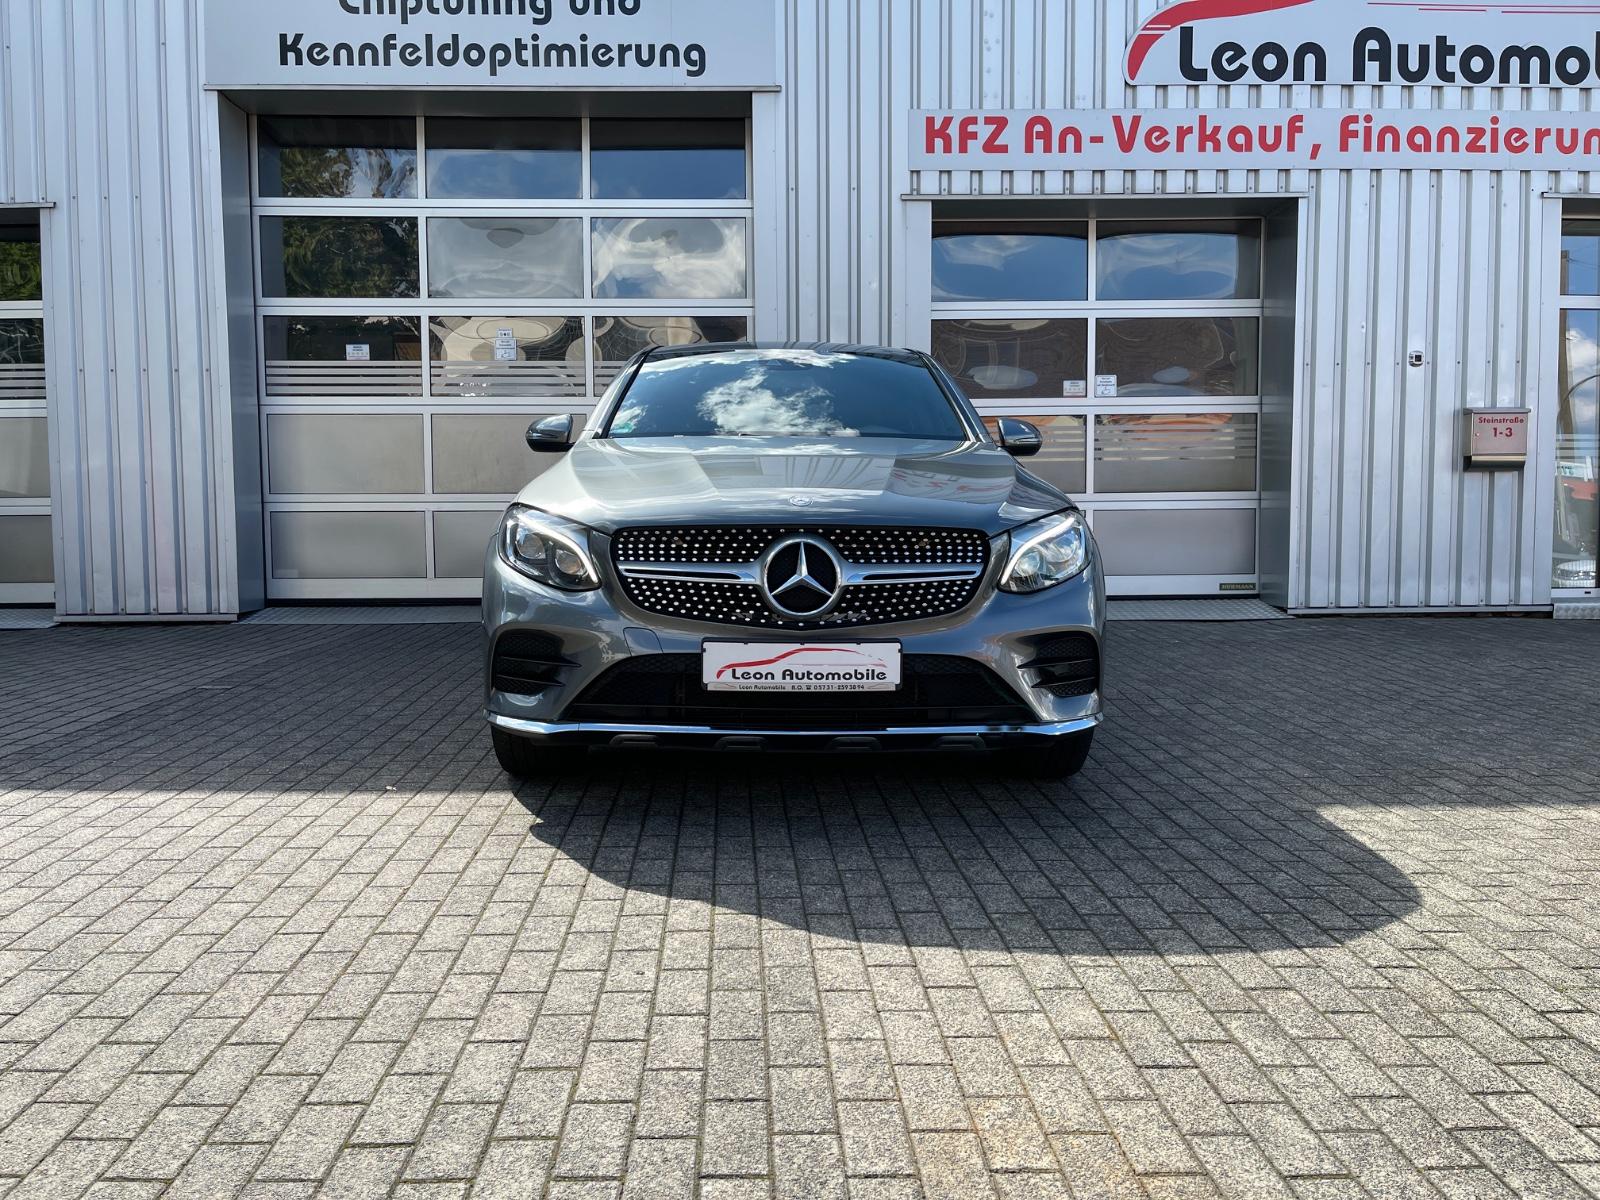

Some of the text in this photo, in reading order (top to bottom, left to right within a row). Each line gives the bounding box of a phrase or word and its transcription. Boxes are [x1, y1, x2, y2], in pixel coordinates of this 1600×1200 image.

[279, 33, 706, 77] Kennfeldoptimierung
[1179, 25, 1600, 86] Leon Automo
[1478, 416, 1525, 424] Steinstraße
[1492, 427, 1513, 437] 1-3
[731, 668, 888, 681] Leon Automobile
